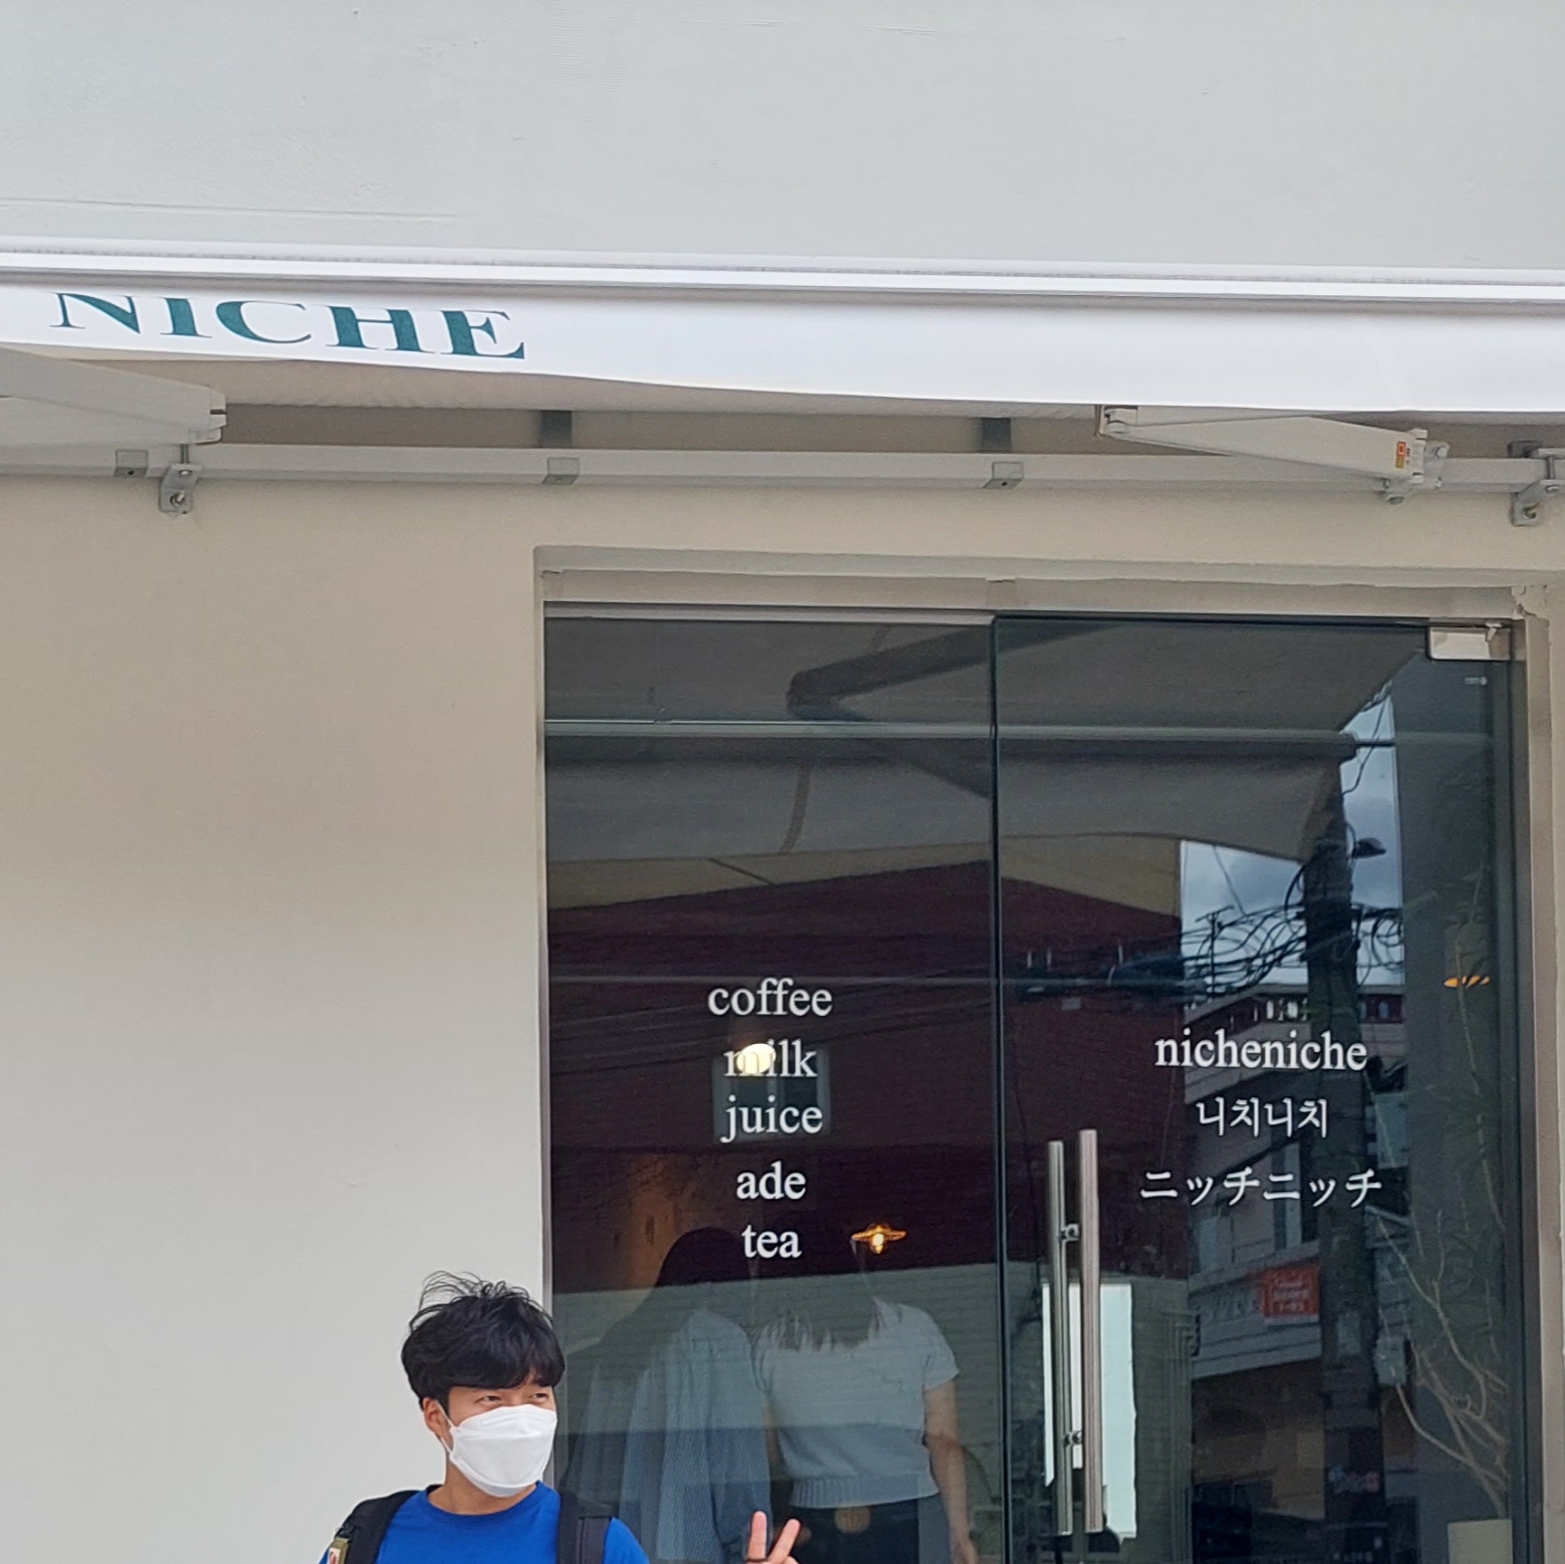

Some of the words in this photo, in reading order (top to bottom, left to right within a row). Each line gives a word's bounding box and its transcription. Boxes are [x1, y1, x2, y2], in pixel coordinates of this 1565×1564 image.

[49, 291, 525, 360] NICHE
[708, 977, 833, 1017] coffee
[723, 1039, 818, 1077] milk
[1155, 1028, 1367, 1071] nicheniche
[720, 1095, 823, 1143] juice
[1196, 1097, 1327, 1138] 니치니치
[736, 1161, 806, 1200] ade
[1140, 1167, 1382, 1207] ニッチニッチ
[741, 1224, 802, 1258] tea
